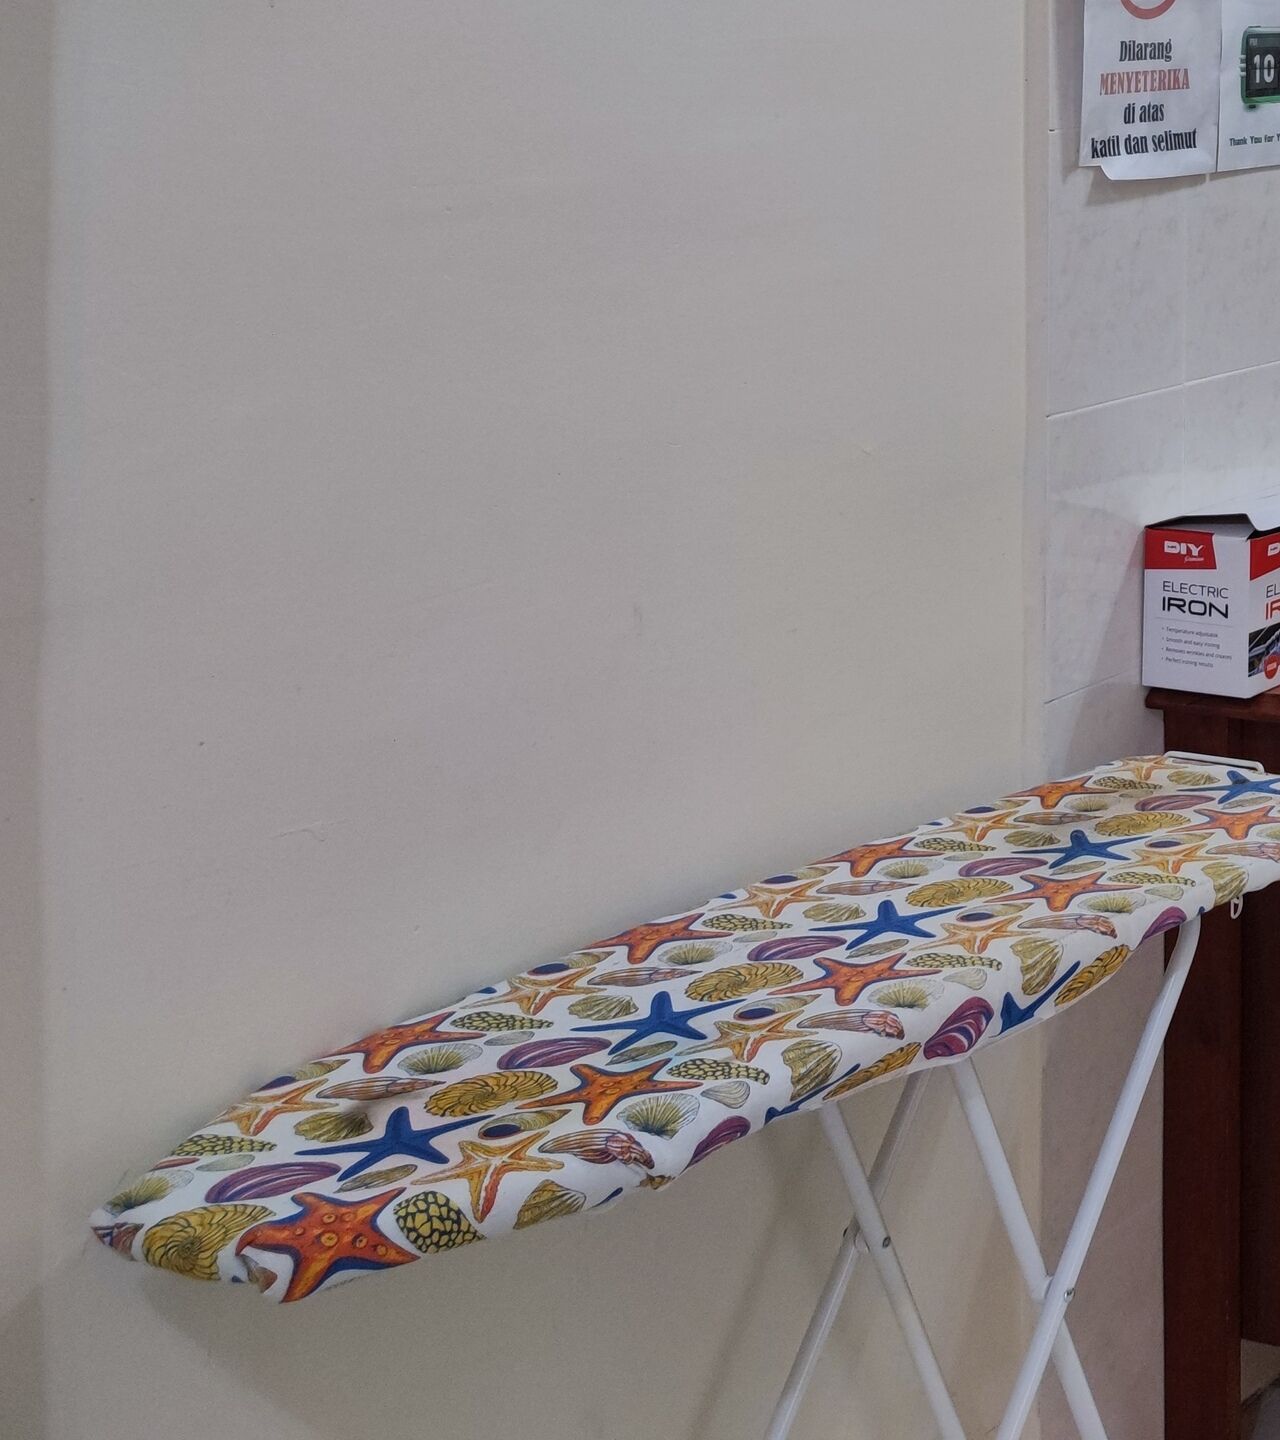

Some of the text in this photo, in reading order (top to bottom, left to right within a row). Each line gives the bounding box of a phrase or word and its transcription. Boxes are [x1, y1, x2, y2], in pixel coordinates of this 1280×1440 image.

[1119, 38, 1172, 62] Dilarang
[1253, 54, 1275, 84] 10
[1099, 68, 1190, 96] MENYETERIKA
[1123, 101, 1165, 124] di atas
[1091, 127, 1198, 159] katil dan selimut
[1229, 137, 1247, 146] Thank
[1250, 135, 1262, 144] You
[1264, 134, 1274, 143] for
[1162, 580, 1229, 599] ELECTRIC
[1162, 596, 1229, 619] IRON
